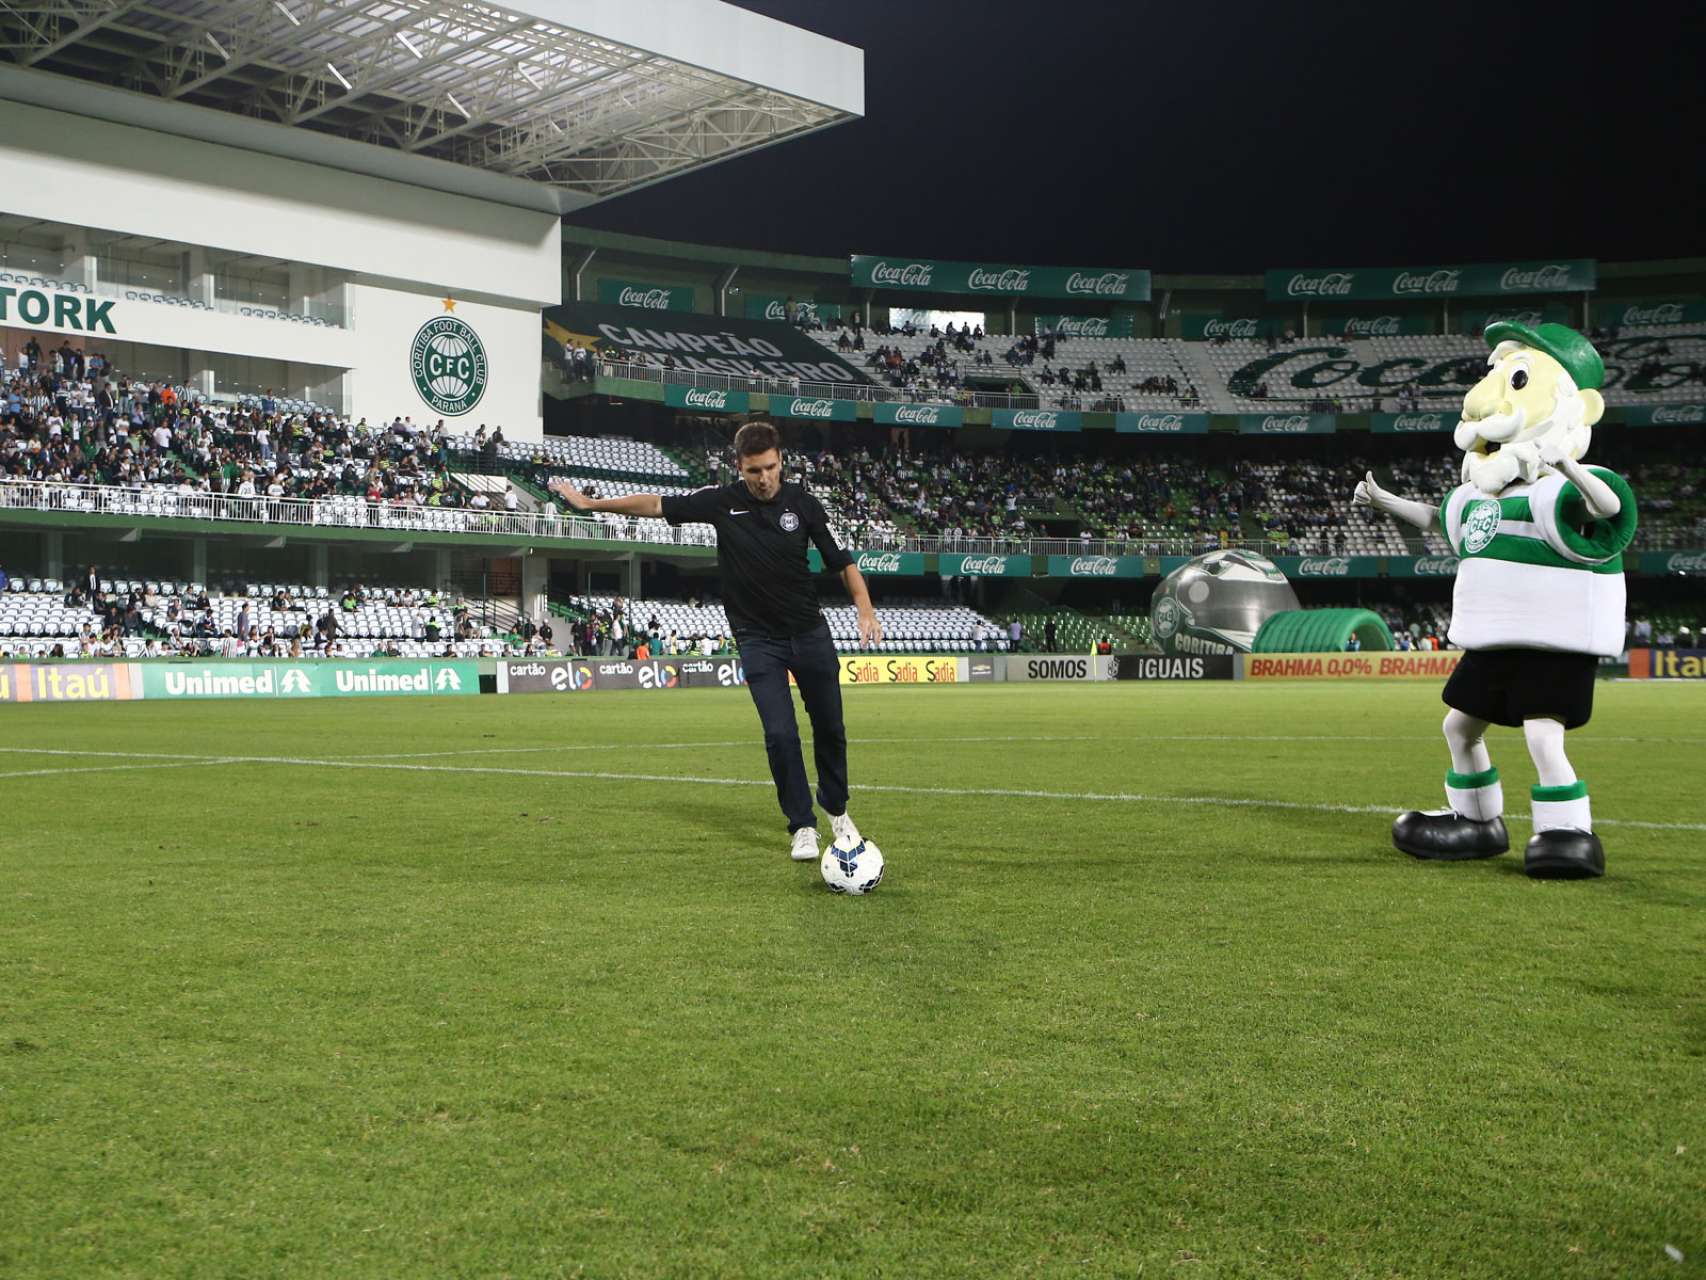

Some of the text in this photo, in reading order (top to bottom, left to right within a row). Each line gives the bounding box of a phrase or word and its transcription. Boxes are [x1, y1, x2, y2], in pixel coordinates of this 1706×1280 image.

[0, 286, 117, 334] TORK
[413, 327, 434, 378] CORITIBA
[598, 323, 783, 357] CAMPEÃO
[429, 353, 470, 380] CFC
[430, 395, 469, 413] PARANÁ
[510, 662, 593, 690] cartão elo
[599, 661, 679, 689] cartão elo
[682, 662, 714, 673] cartão
[846, 660, 956, 683] Sadia Sadia Sadia
[1028, 658, 1204, 679] SOMOS IGUAIS
[1251, 657, 1458, 677] BRAHMA 0,0% BRAHMA
[1655, 650, 1706, 677] Ita
[37, 667, 110, 699] Itaú
[165, 670, 273, 696] Unimed
[336, 669, 430, 691] Unimed
